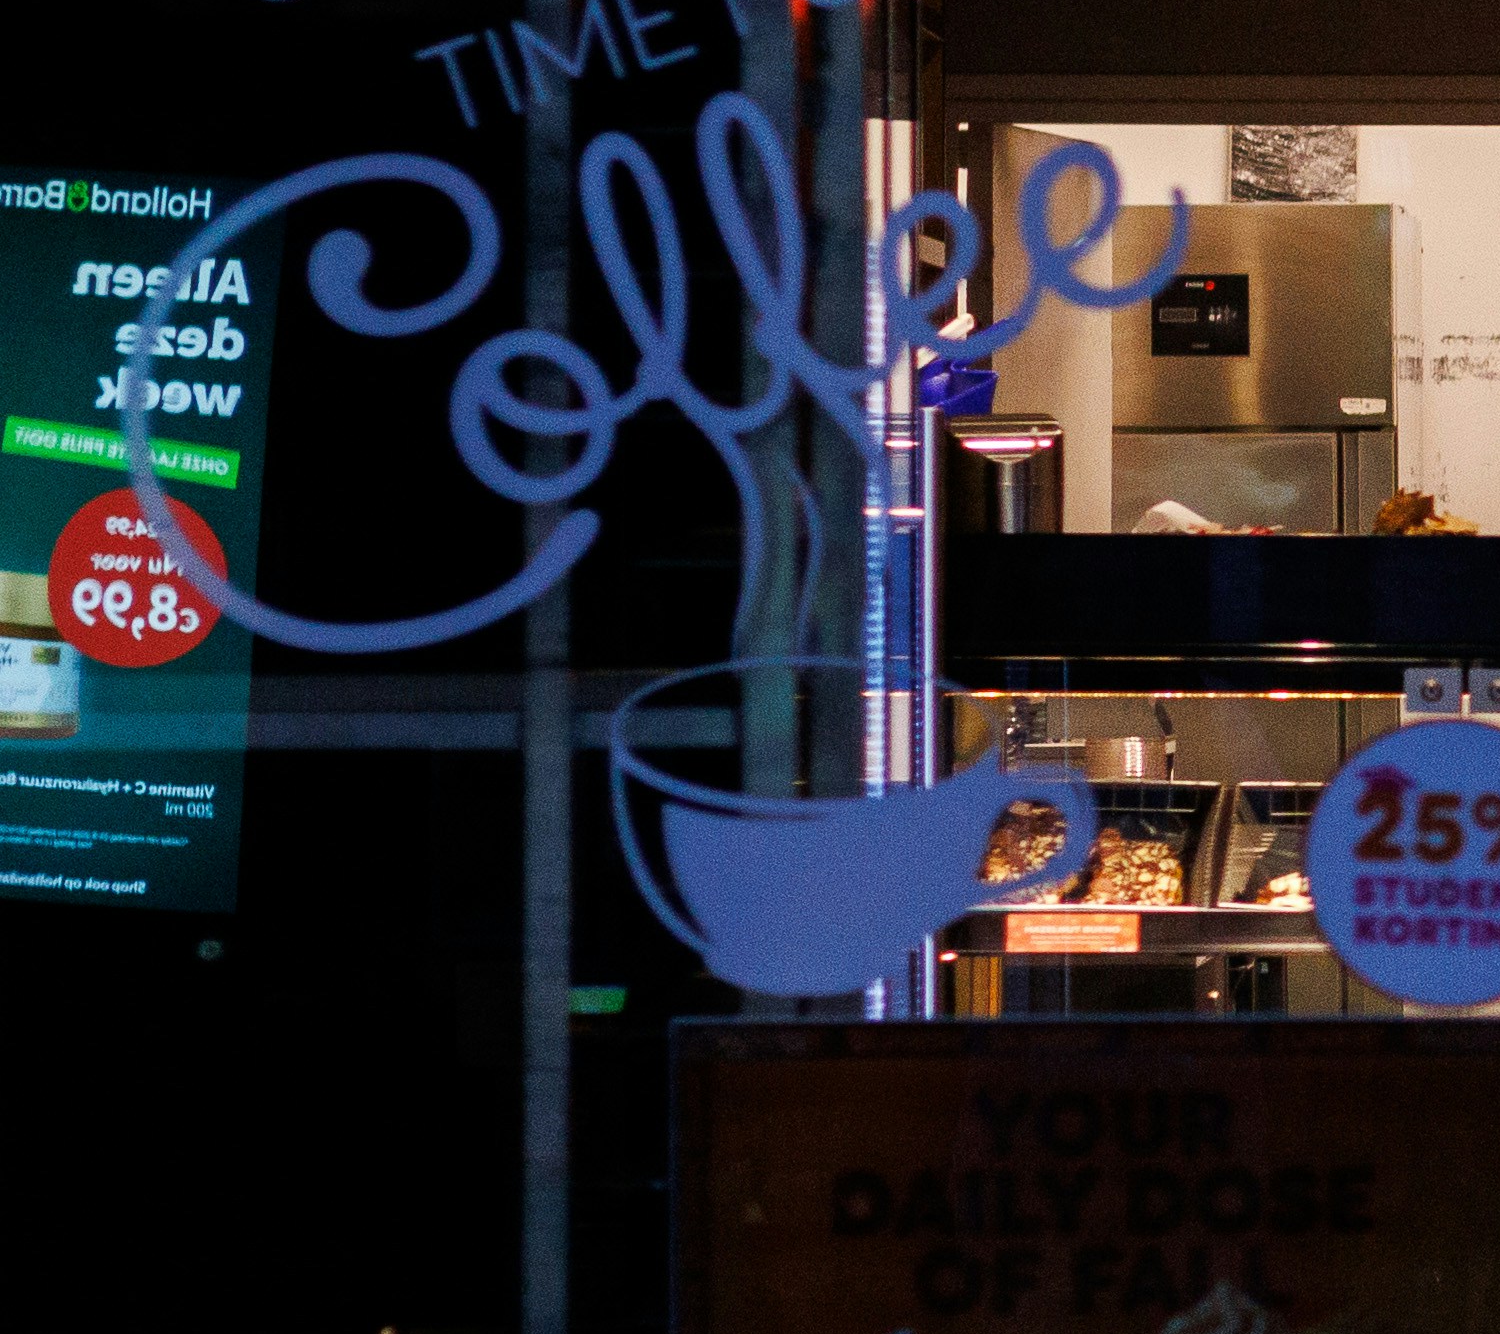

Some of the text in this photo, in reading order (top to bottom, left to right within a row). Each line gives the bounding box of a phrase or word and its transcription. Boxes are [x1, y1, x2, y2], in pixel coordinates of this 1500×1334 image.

[124, 91, 1192, 655] Coffee
[976, 1088, 1231, 1159] YOUR
[833, 1164, 1376, 1238] DAILY DOSE
[914, 1246, 1038, 1315] OF
